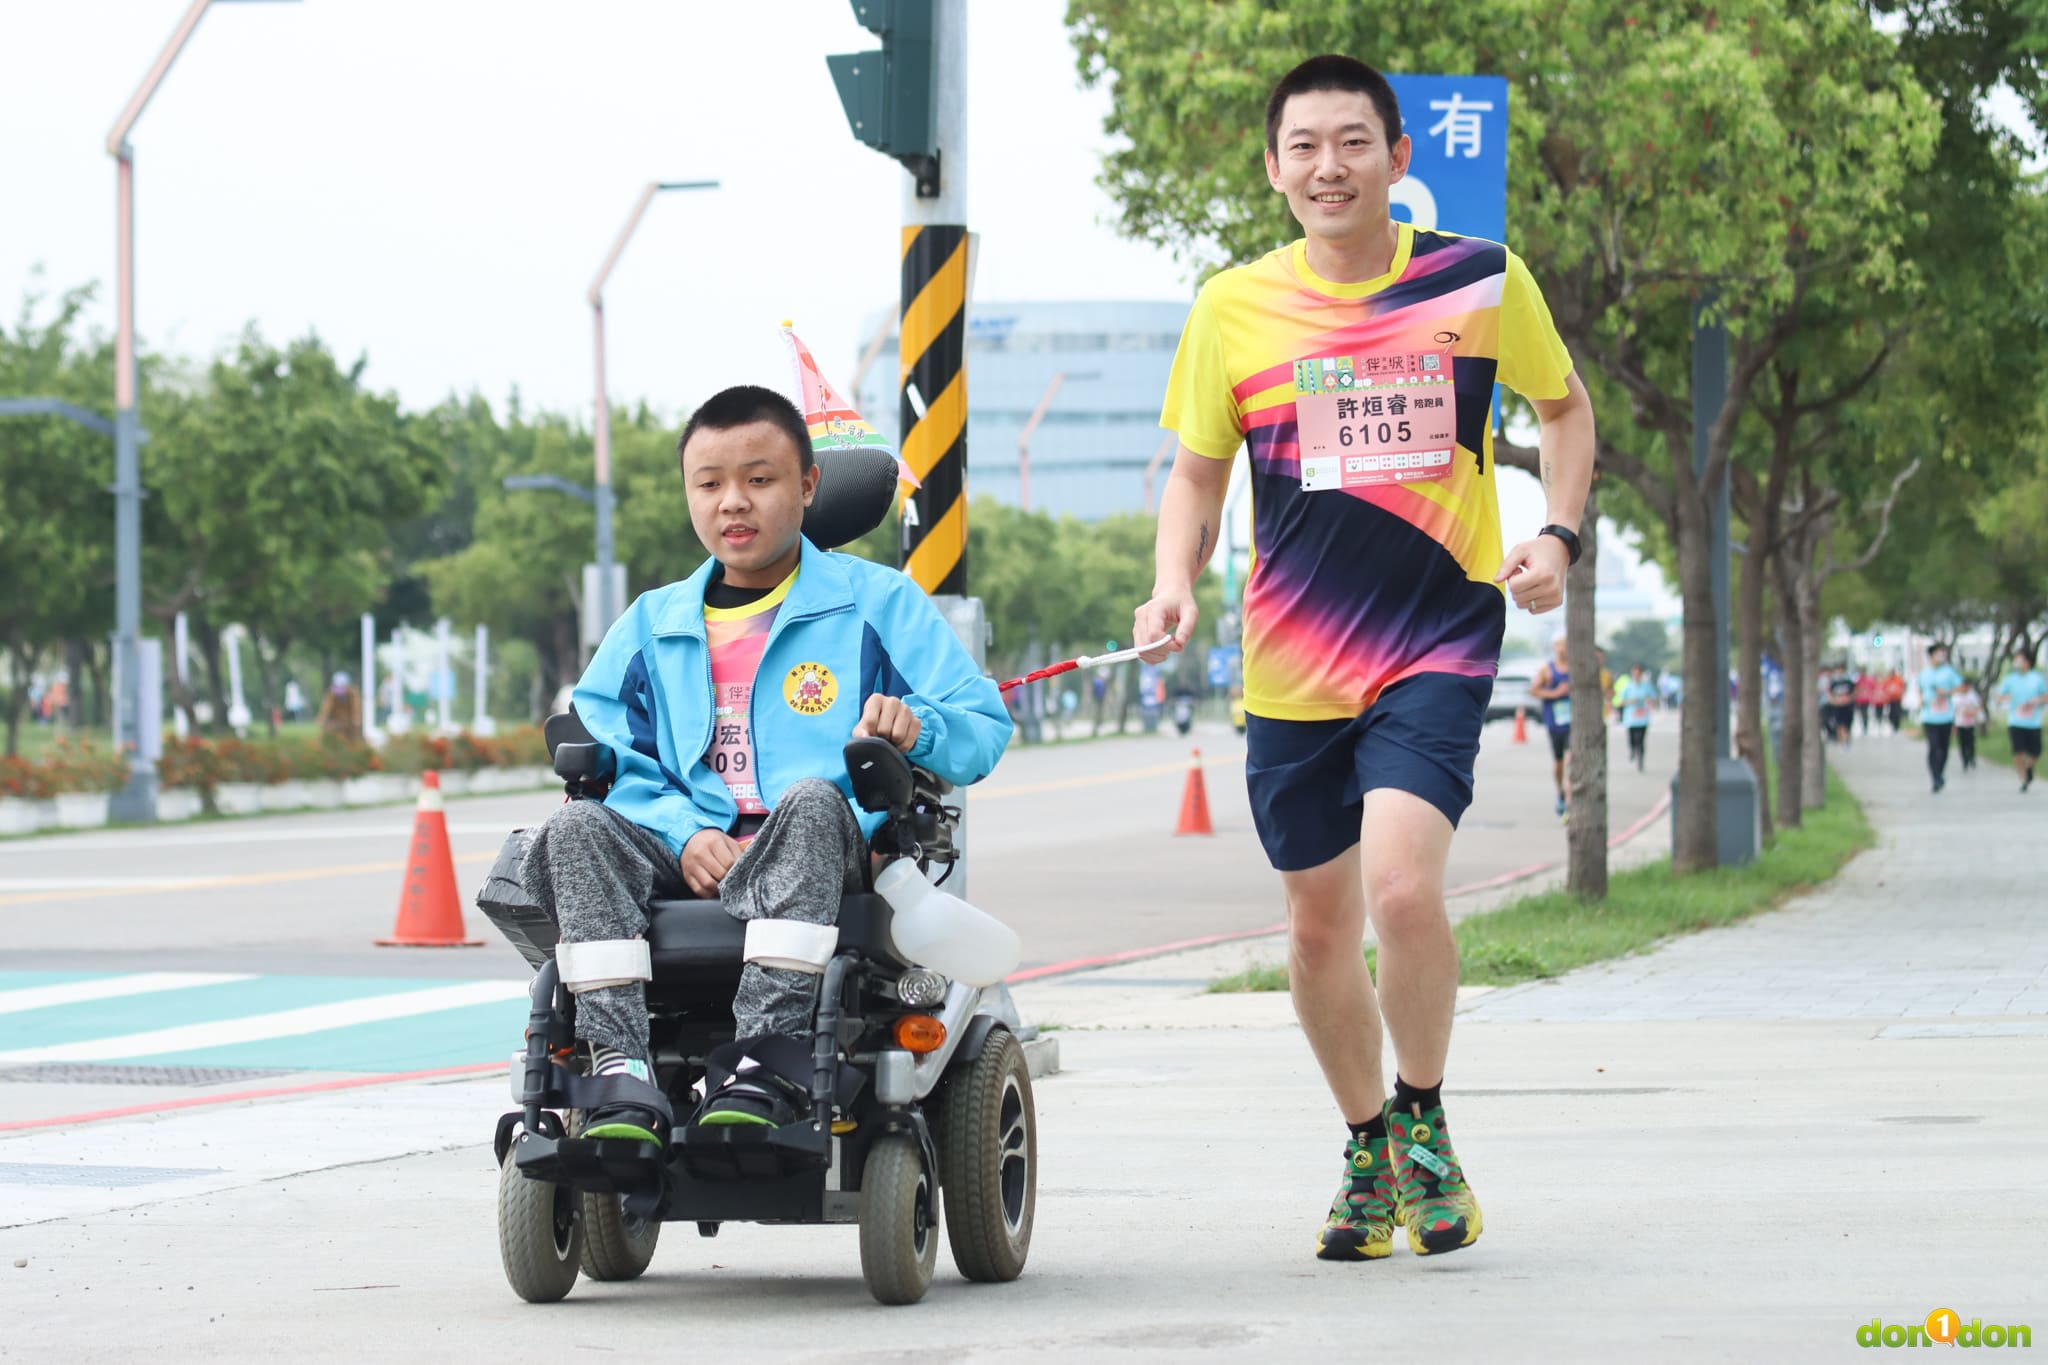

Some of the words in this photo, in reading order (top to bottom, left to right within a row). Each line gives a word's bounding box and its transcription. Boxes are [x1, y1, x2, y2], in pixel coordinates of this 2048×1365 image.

[1402, 92, 1494, 159] 有
[1336, 394, 1407, 420] 許烜睿
[1414, 397, 1443, 409] 陪跑員
[1339, 421, 1412, 446] 6105
